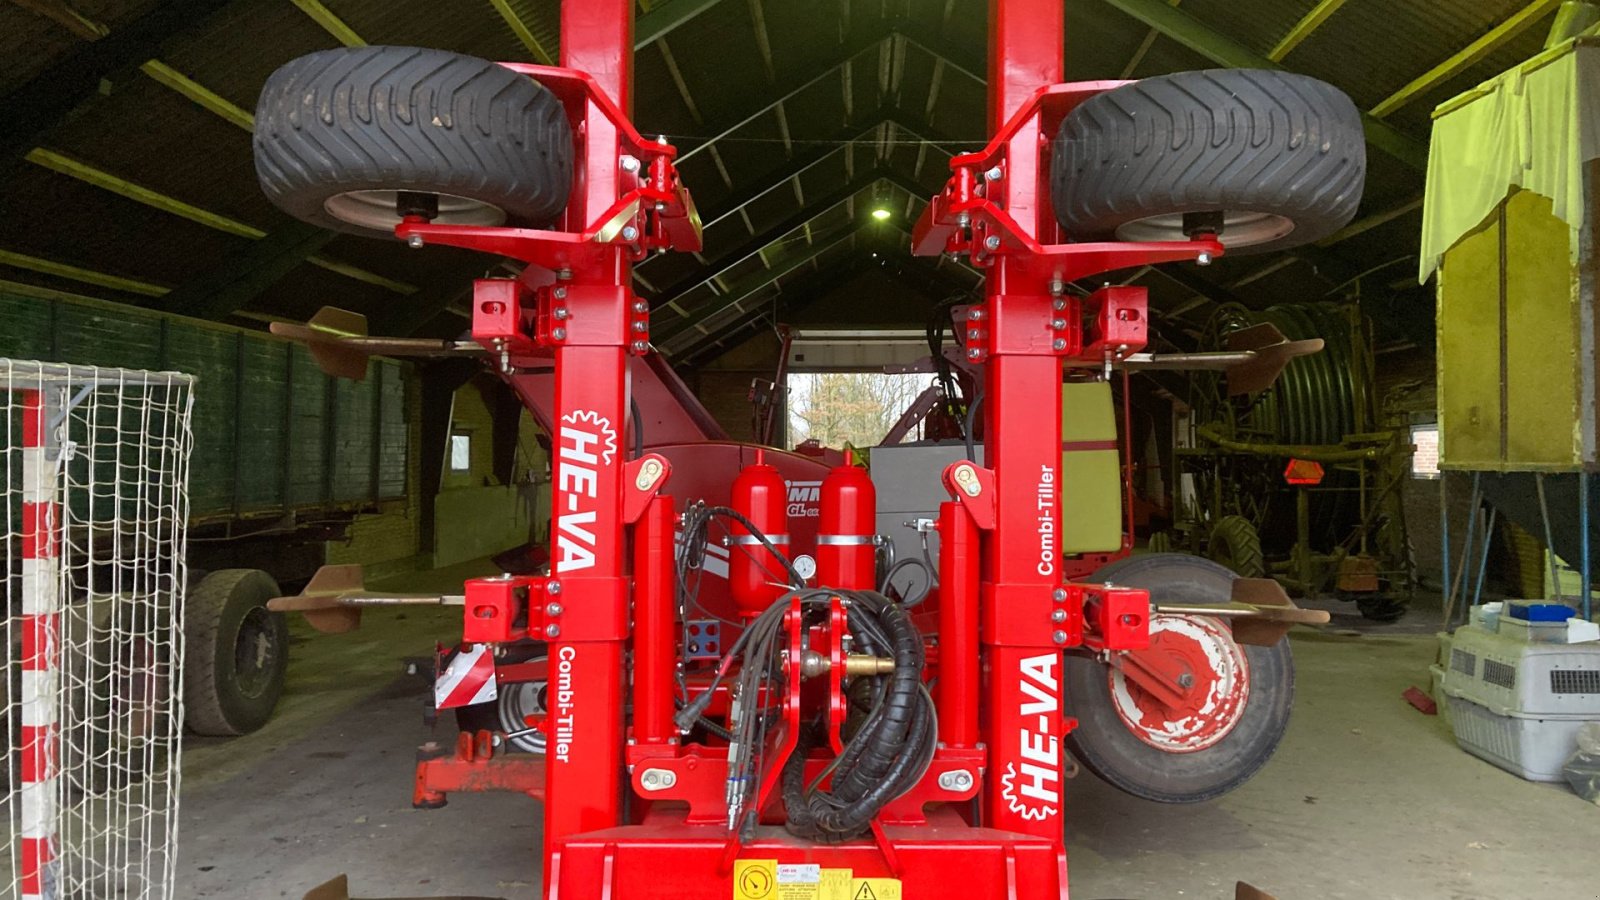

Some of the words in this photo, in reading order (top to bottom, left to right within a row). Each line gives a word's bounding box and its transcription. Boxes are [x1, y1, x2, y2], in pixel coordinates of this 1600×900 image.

[557, 427, 598, 573] HE-VA
[786, 503, 806, 517] GL
[1037, 465, 1054, 576] Combi-Tiller
[556, 646, 576, 763] Combi-Tiller
[1020, 654, 1058, 803] HE-VA
